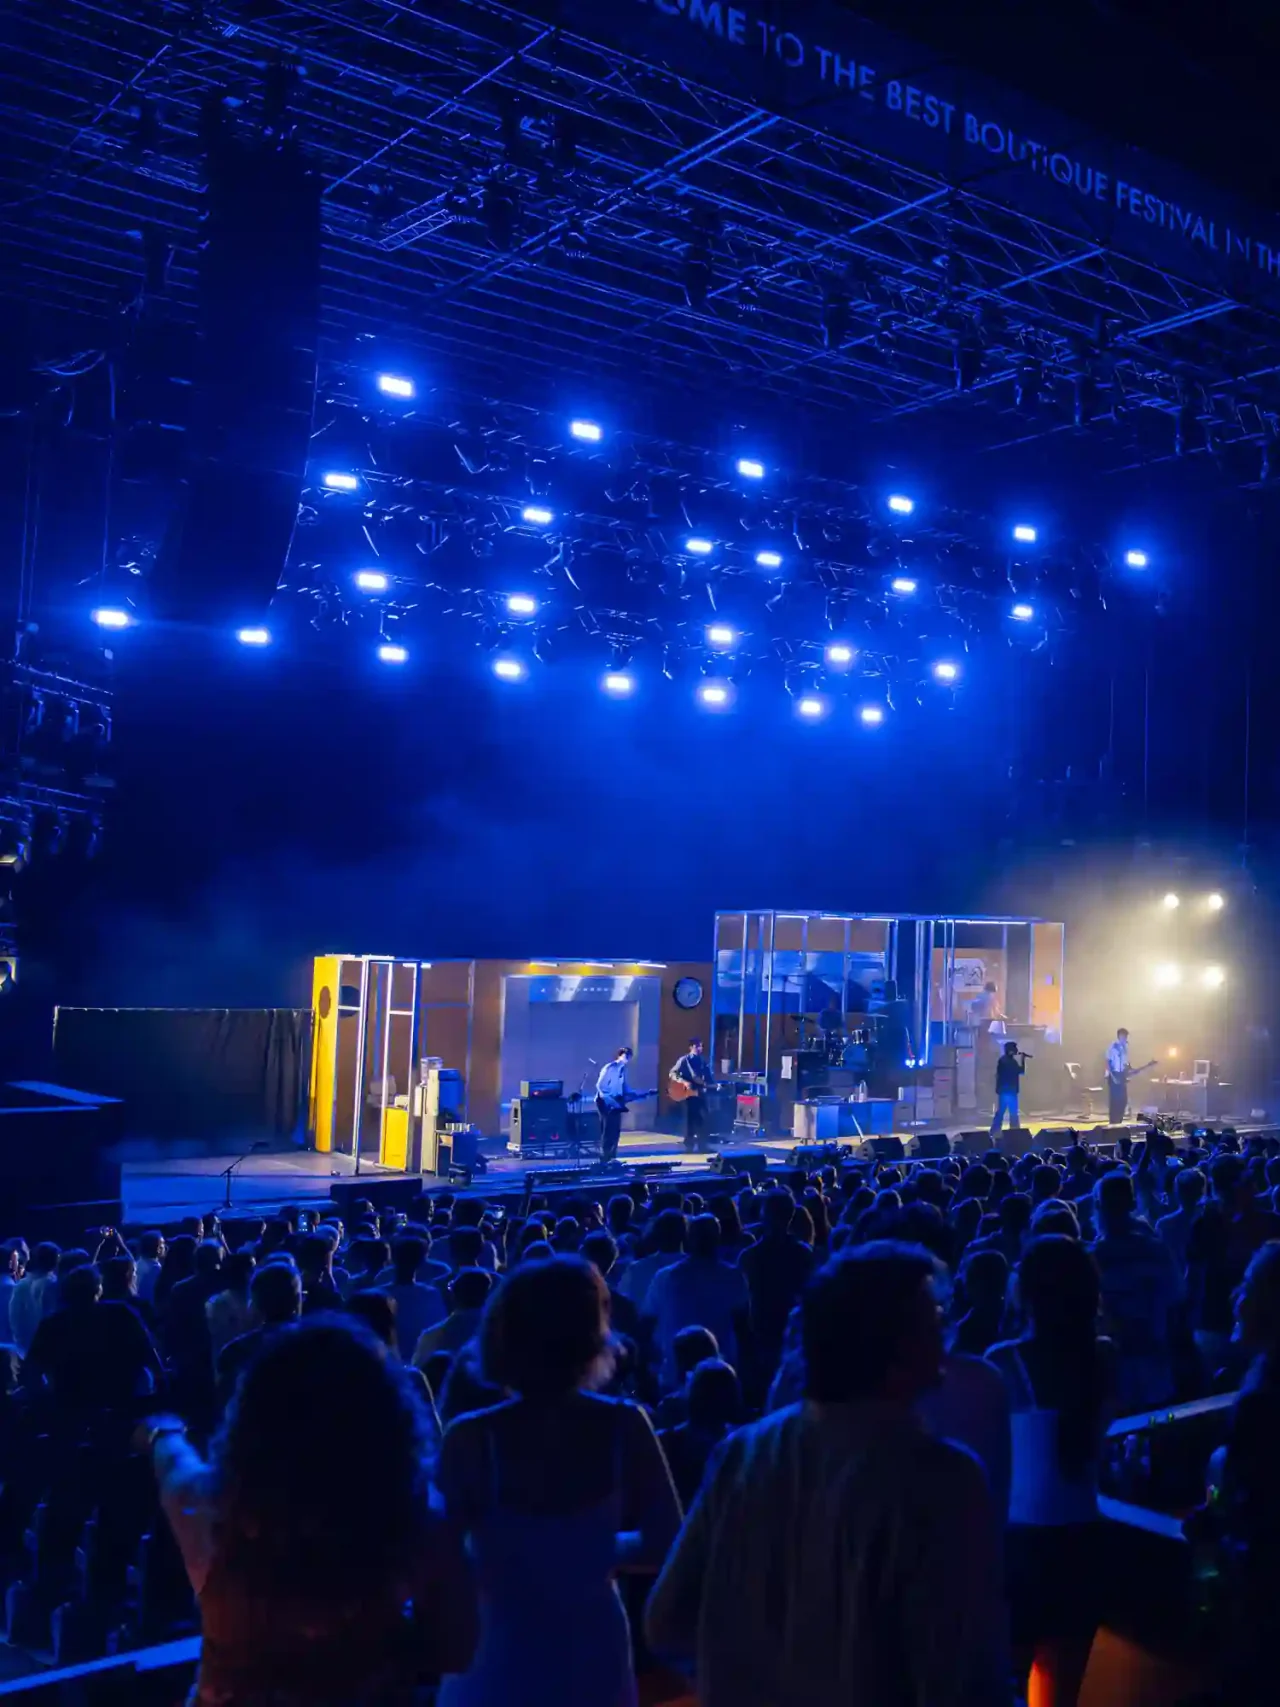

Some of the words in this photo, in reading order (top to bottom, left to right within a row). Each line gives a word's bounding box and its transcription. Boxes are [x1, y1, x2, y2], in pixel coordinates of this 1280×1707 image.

[756, 20, 804, 67] TO
[814, 45, 877, 102] THE
[884, 79, 956, 135] BEST
[964, 111, 1109, 201] BOUTIQUE
[1115, 180, 1220, 251] FESTIVAL
[1225, 228, 1251, 261] IN
